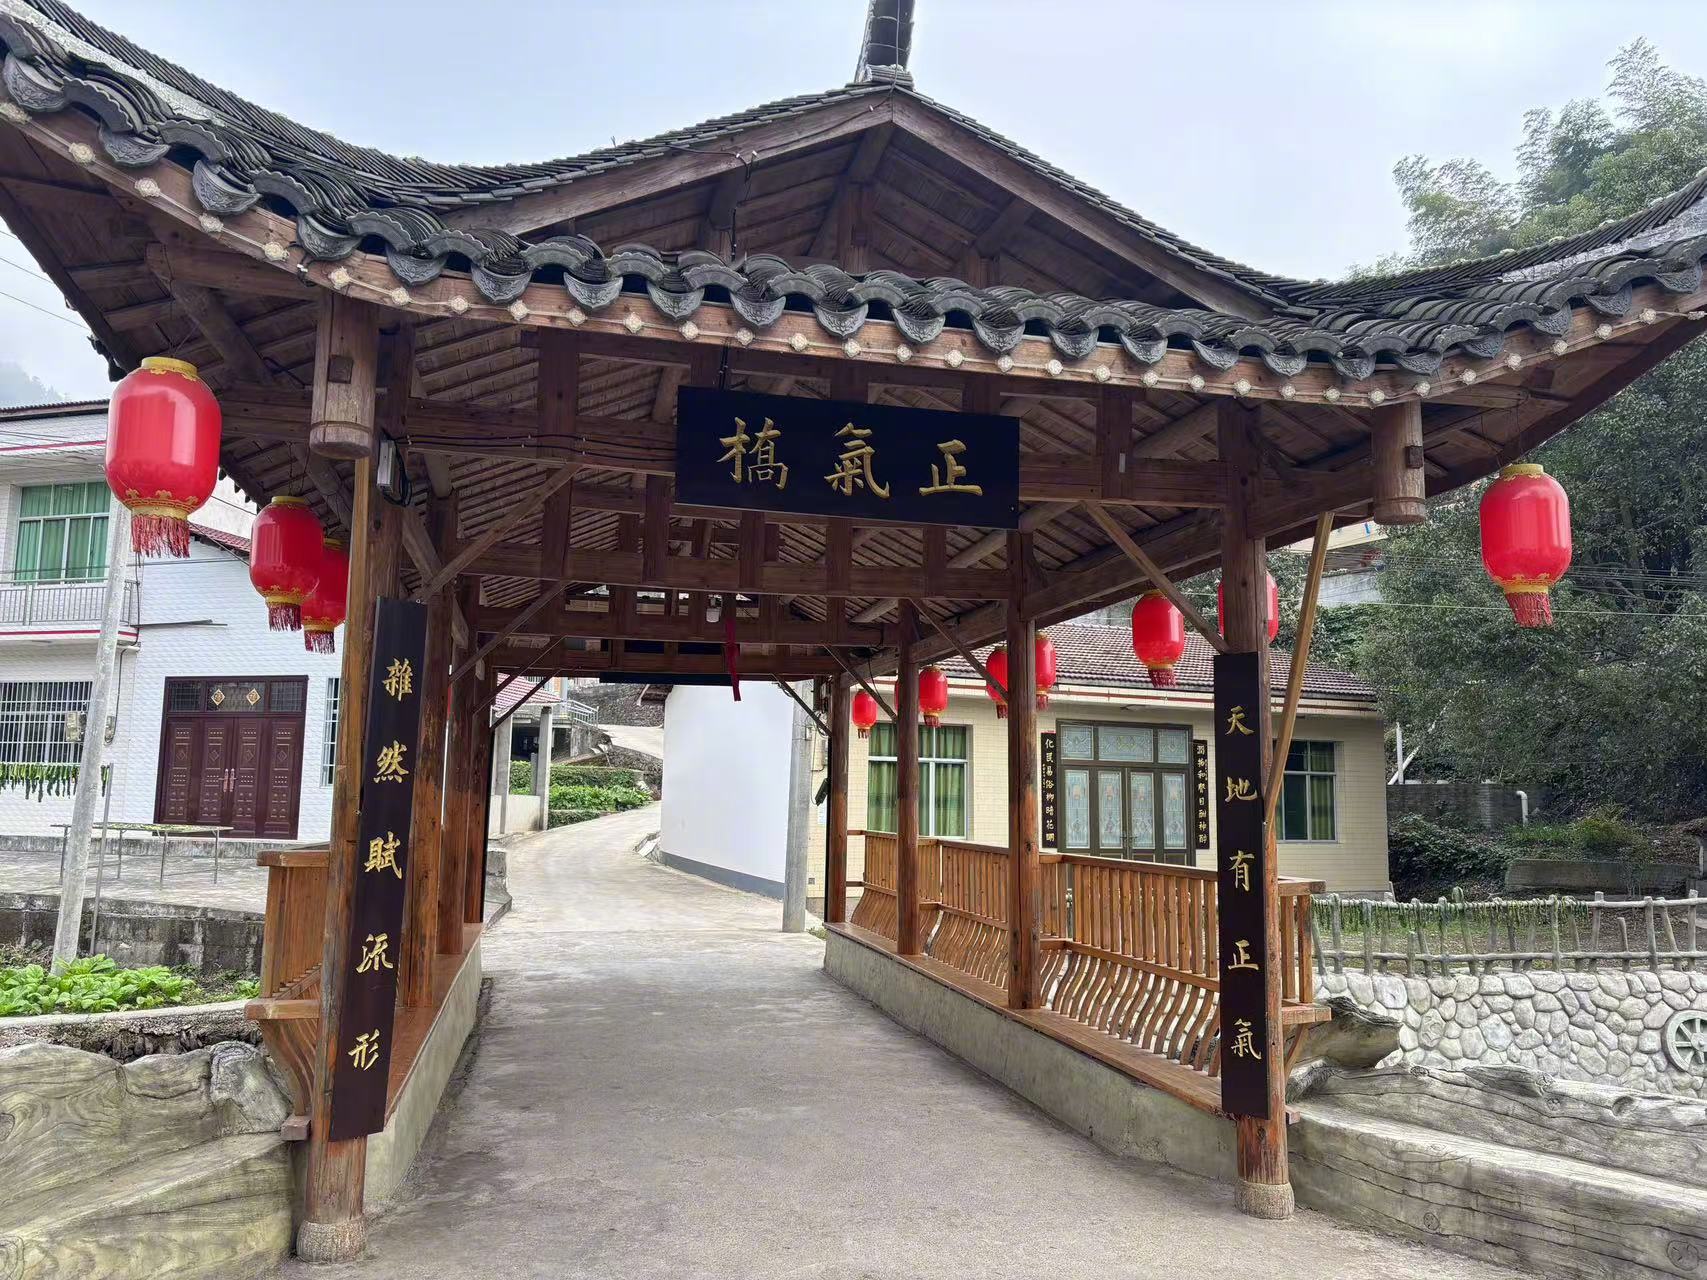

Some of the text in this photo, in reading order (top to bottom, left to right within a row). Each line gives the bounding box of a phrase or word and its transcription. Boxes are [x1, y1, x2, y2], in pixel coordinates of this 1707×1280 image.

[347, 657, 414, 1072] 雜然賦流形
[1225, 705, 1262, 1061] 天地有正氣
